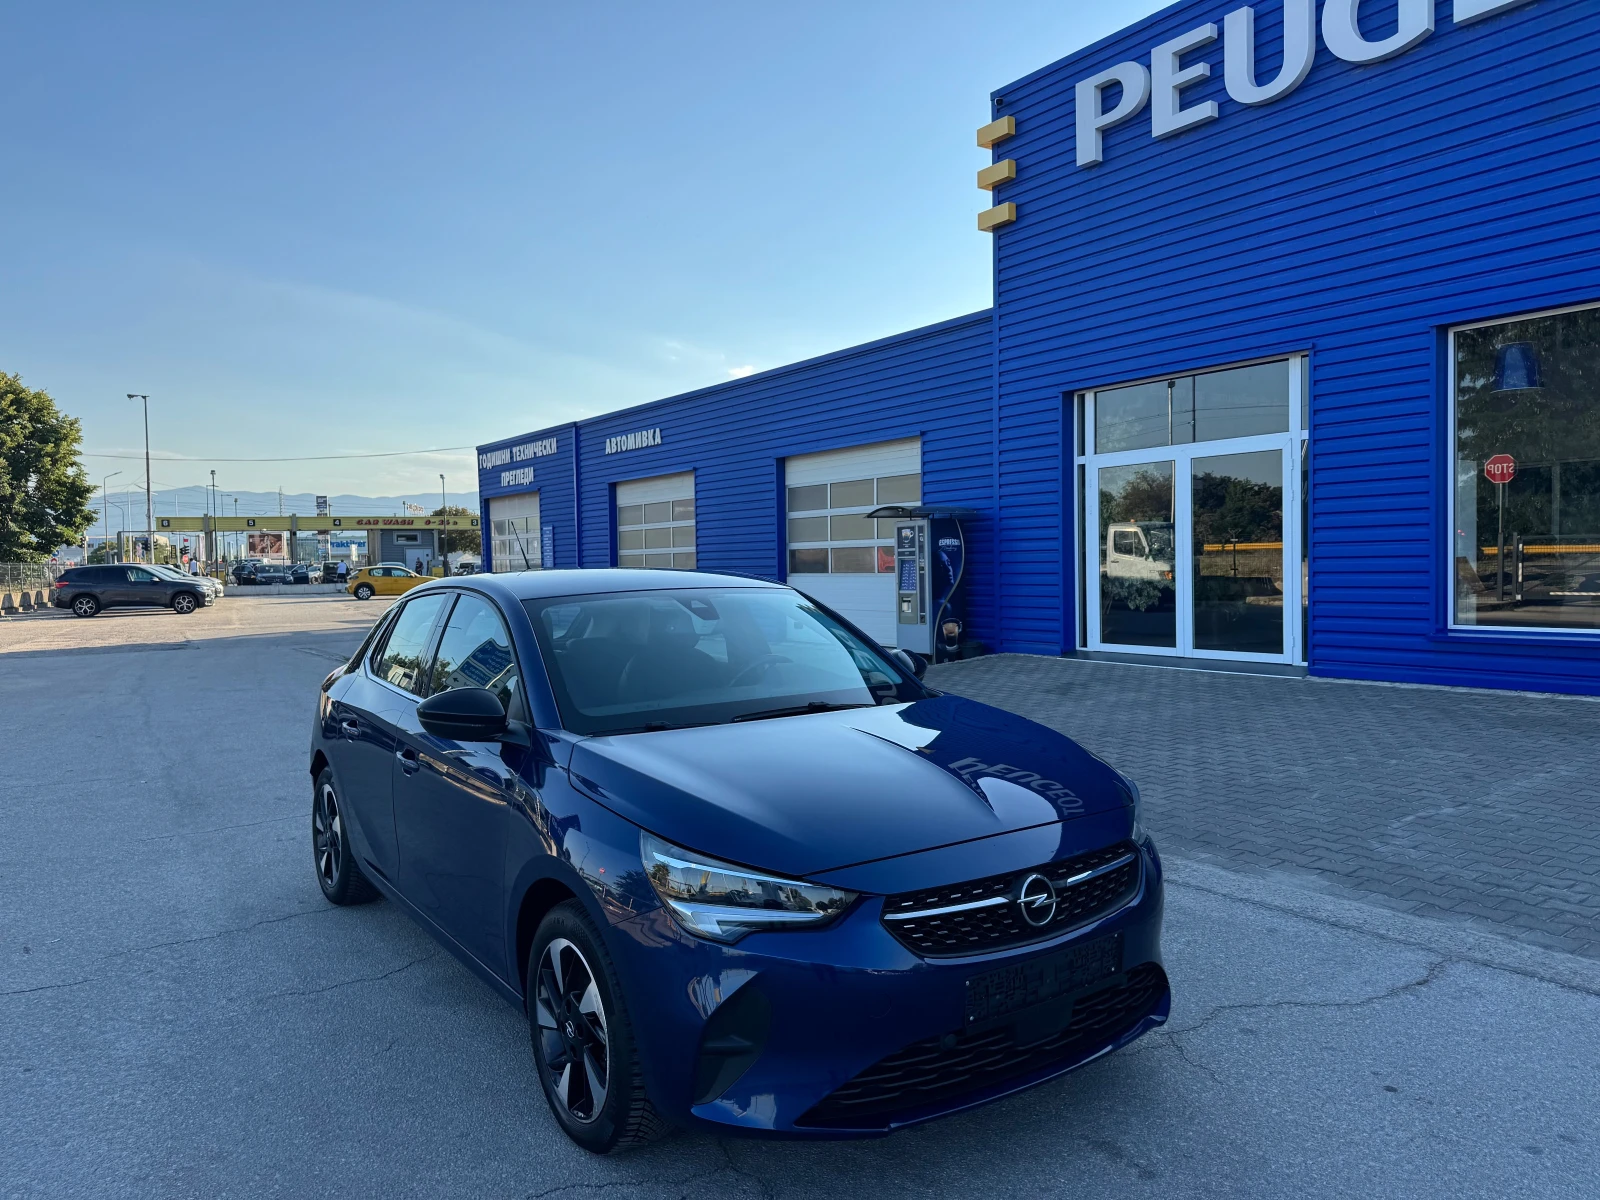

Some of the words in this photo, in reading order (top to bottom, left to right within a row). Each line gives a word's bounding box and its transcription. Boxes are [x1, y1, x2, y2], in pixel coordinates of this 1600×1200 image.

[1075, 0, 1538, 167] PEUG
[479, 448, 511, 470] ГОДИШНИ
[512, 437, 557, 462] ТЕХНИЧЕСКИ
[605, 427, 662, 455] АВТОМИВКА
[501, 466, 534, 487] ПРЕГЛЕДИ
